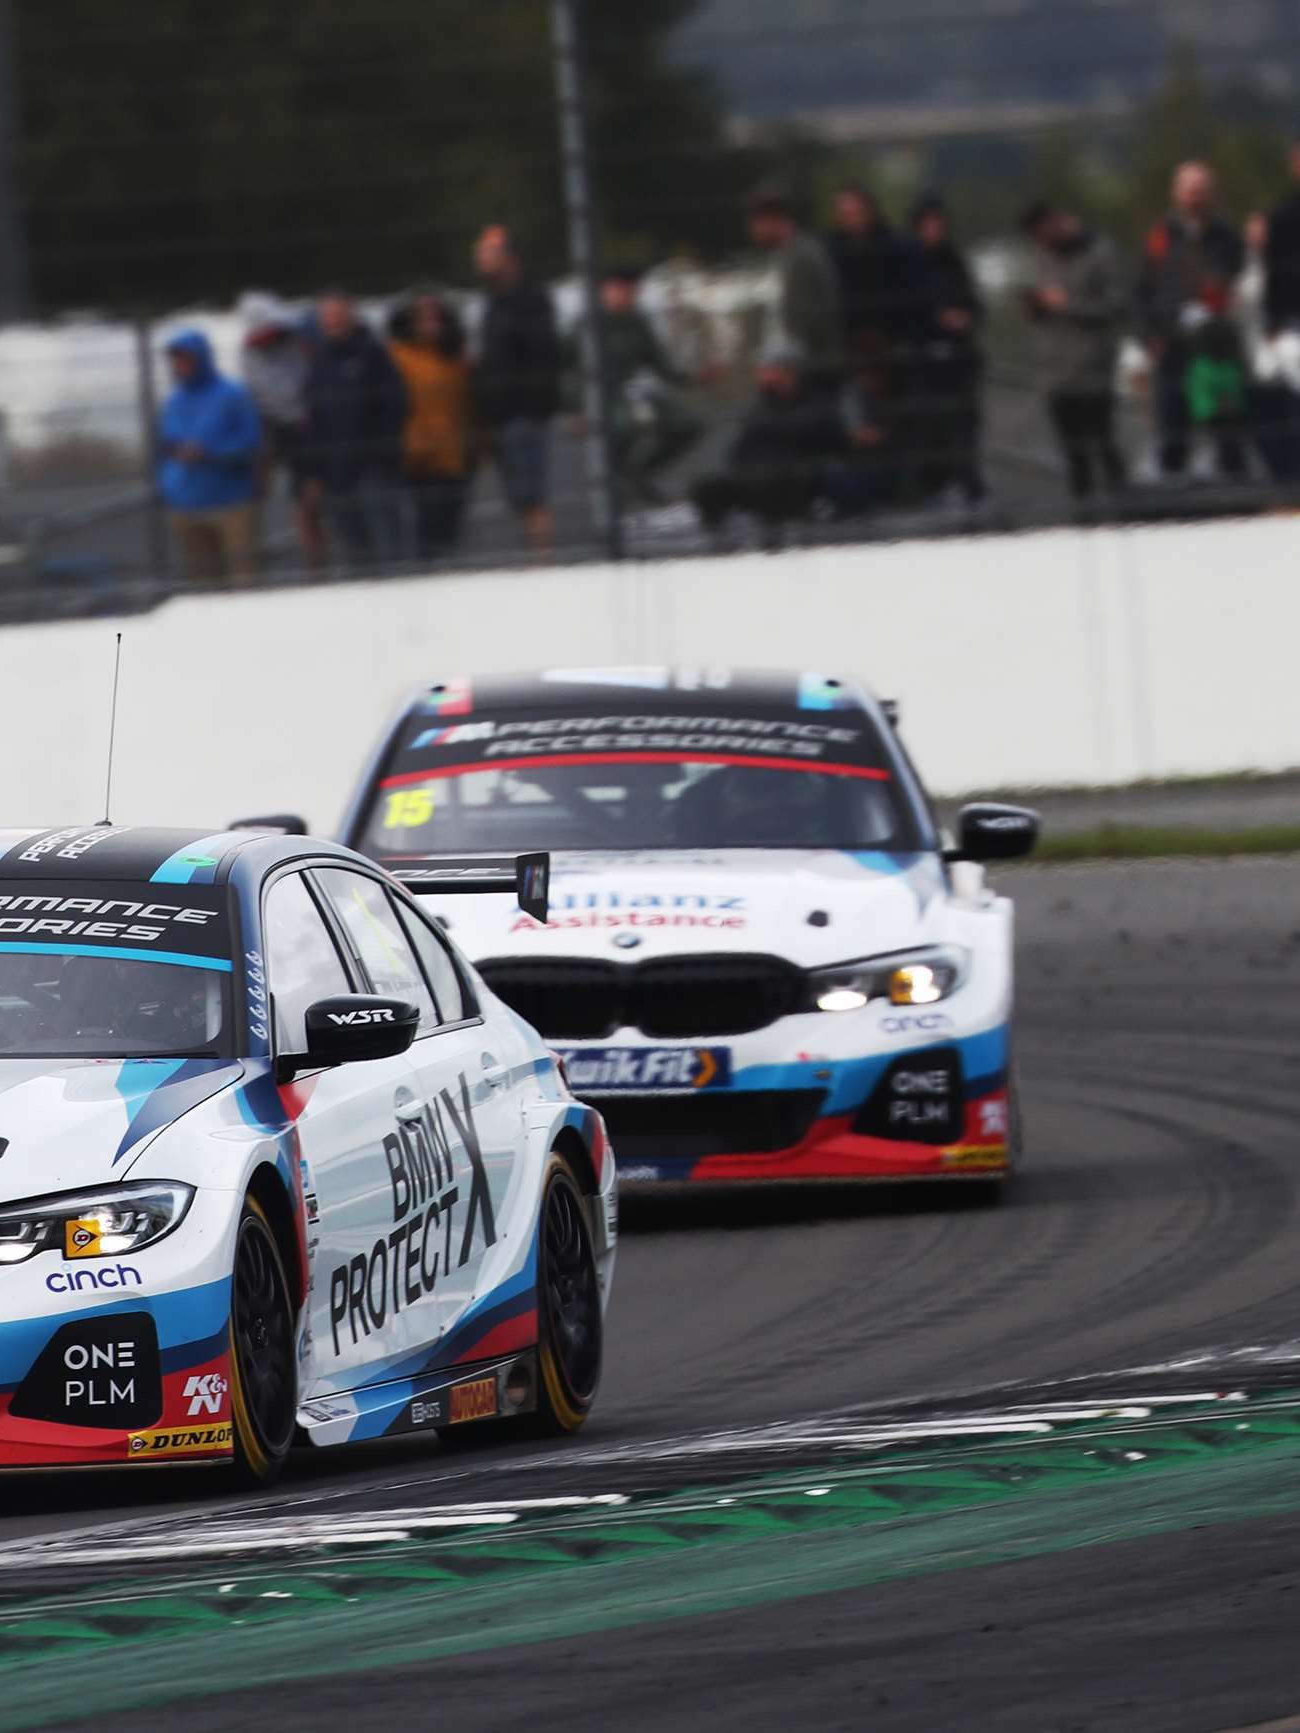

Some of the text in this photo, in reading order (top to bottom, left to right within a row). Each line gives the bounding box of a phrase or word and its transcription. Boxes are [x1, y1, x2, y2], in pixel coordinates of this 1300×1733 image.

[494, 716, 860, 743] PERFORMANCE
[483, 734, 827, 757] ACCESSORIES
[383, 789, 434, 829] 15
[327, 1008, 396, 1026] WSR
[382, 1097, 453, 1223] BMW
[46, 1264, 142, 1293] cinch
[330, 1186, 458, 1356] PROTECT
[64, 1342, 135, 1370] ONE
[65, 1378, 135, 1406] PLM
